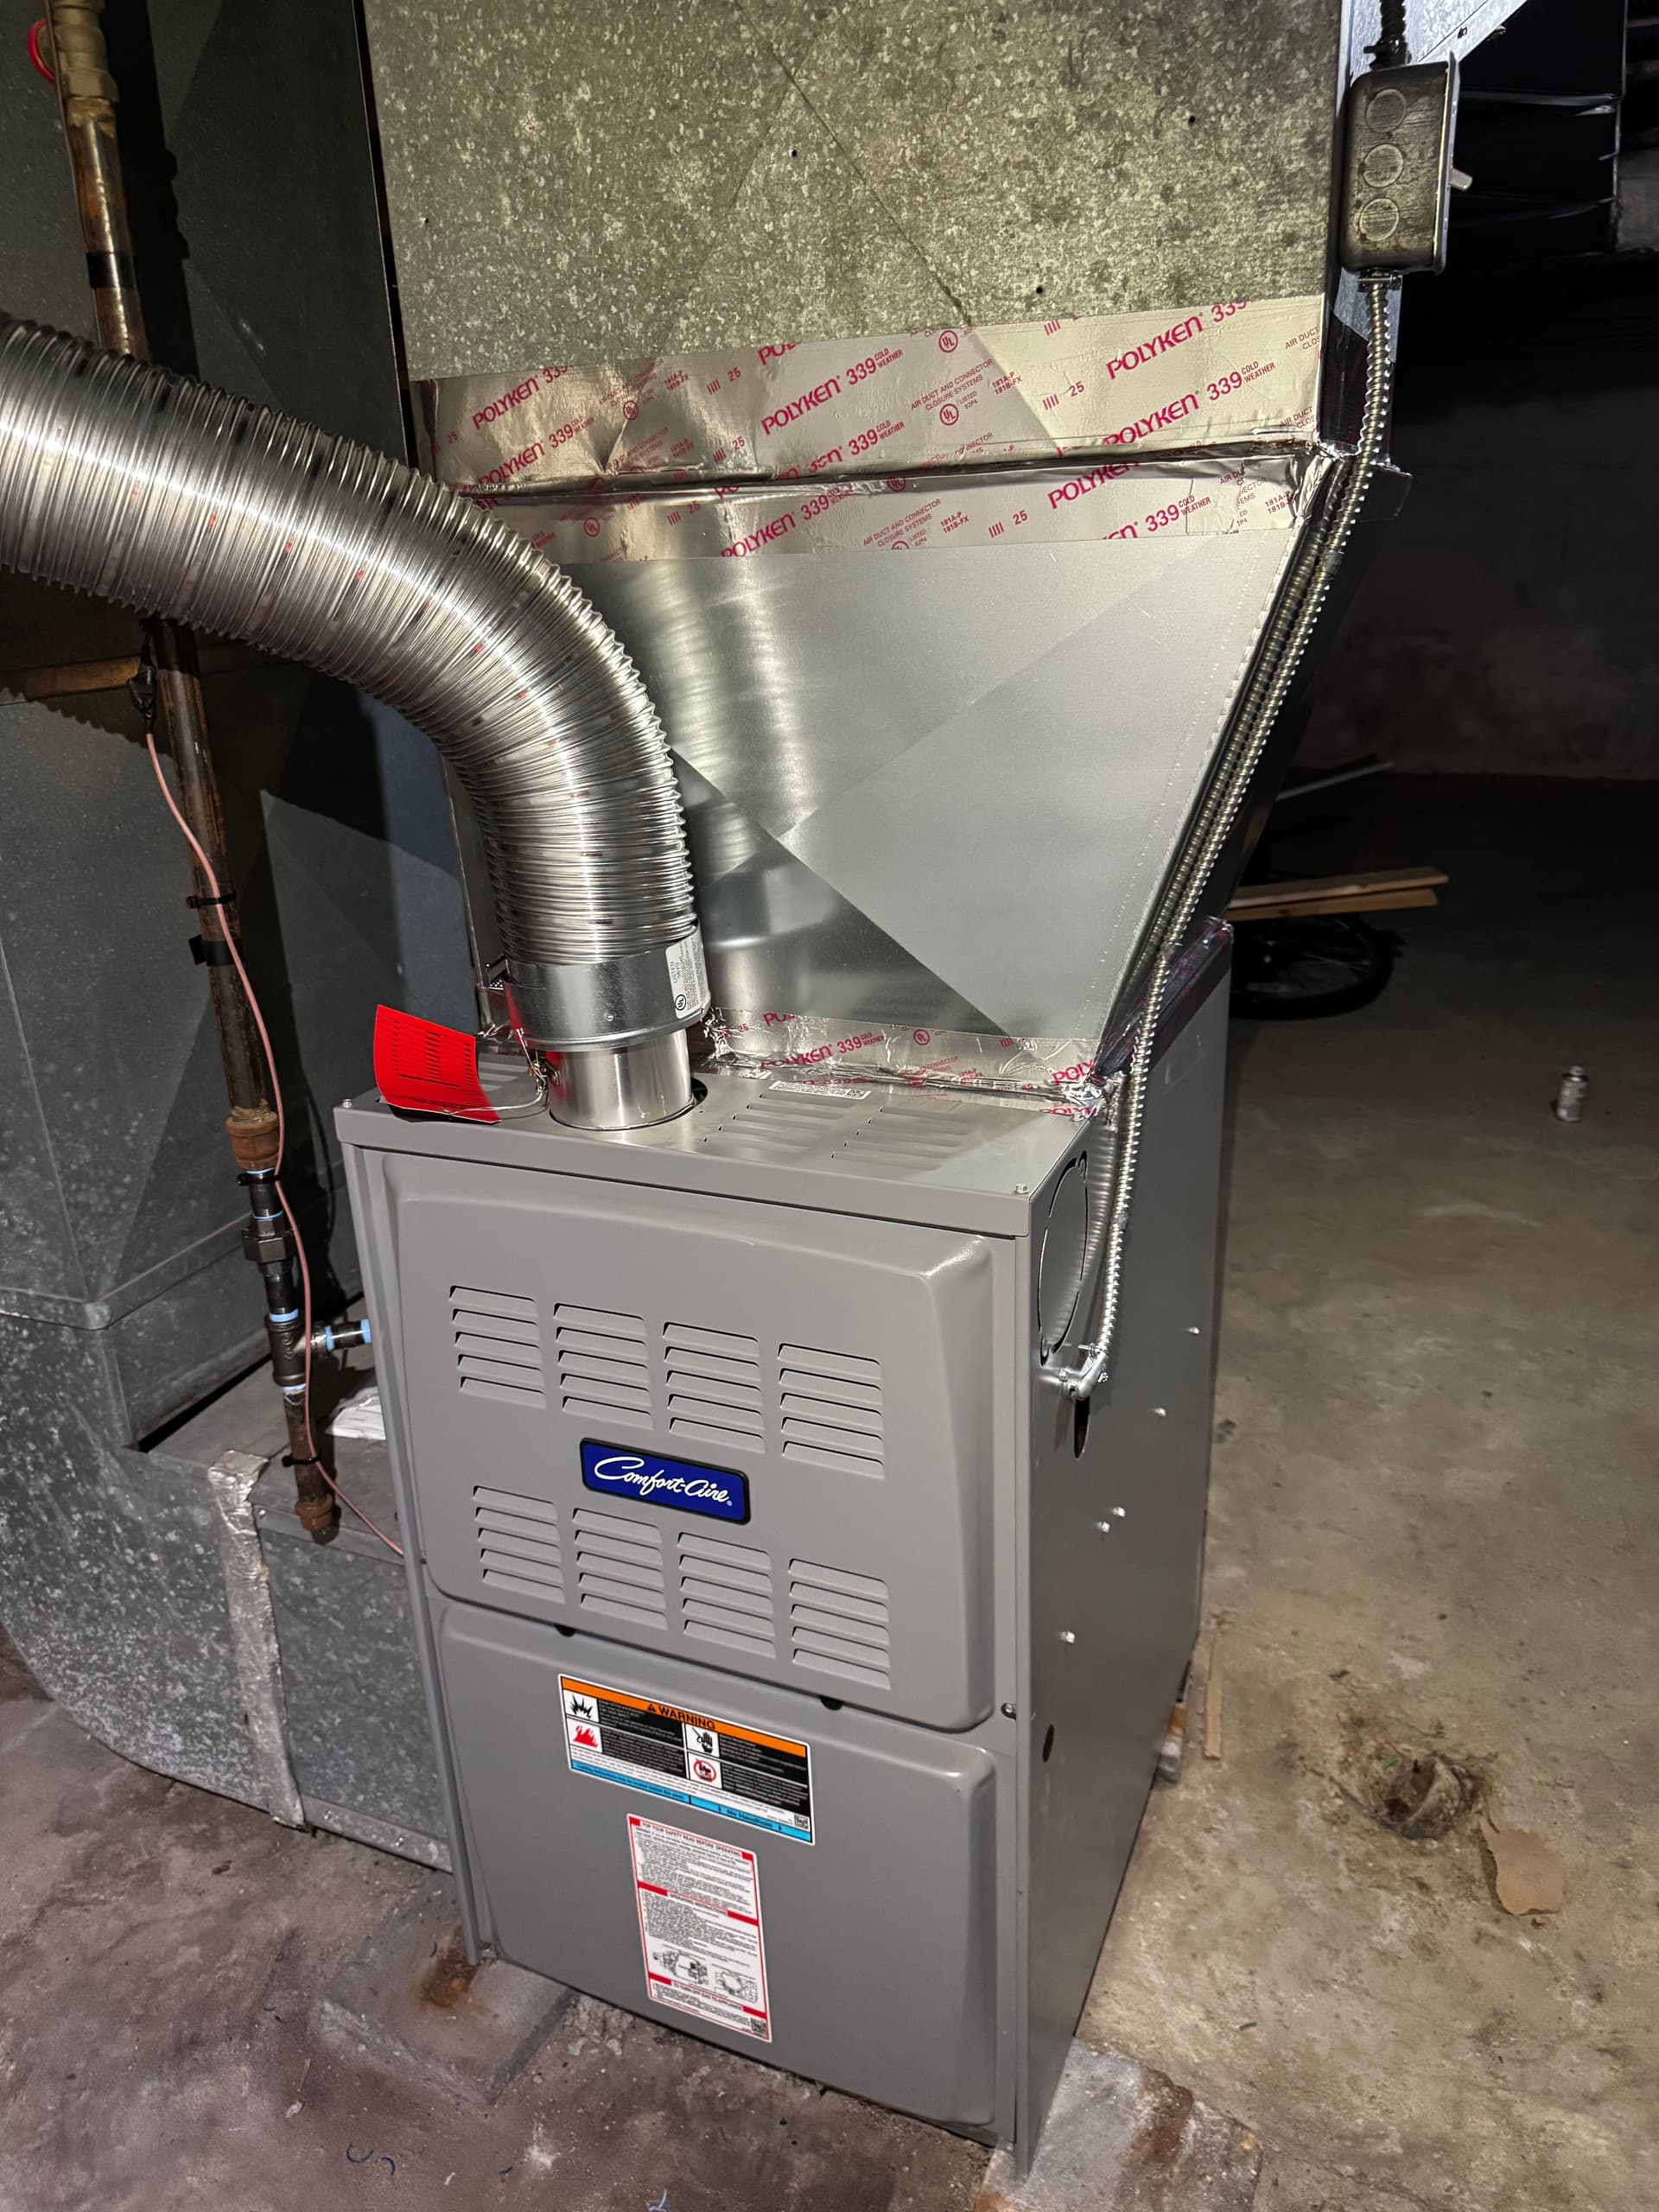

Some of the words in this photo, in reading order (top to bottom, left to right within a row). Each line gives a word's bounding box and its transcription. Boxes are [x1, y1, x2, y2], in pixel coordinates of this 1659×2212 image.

[1105, 315, 1204, 381] POLYKEN
[1284, 337, 1298, 350] AIR
[1299, 325, 1319, 341] DUCT
[877, 348, 904, 369] WEATHER
[728, 366, 741, 383] 25
[910, 399, 922, 410] AIR
[922, 391, 939, 405] DUCT
[940, 381, 954, 394] AND
[954, 358, 994, 385] CONNECTOR
[1243, 361, 1276, 384] WEATHER
[760, 377, 842, 435] POLYKEN
[846, 357, 876, 385] 339
[873, 347, 889, 361] COLD
[925, 390, 954, 411] CLOSURE
[954, 373, 984, 395] SYSTEMS
[958, 390, 978, 405] LISTED
[1068, 381, 1085, 397] 25
[472, 377, 540, 430] POLYKEN
[1103, 391, 1200, 446] POLYKEN
[1206, 371, 1243, 402] 339
[1240, 360, 1259, 376] COLD
[1294, 405, 1313, 423] DUCT
[549, 423, 575, 448] 339
[732, 435, 746, 451] 25
[848, 429, 879, 456] 339
[875, 419, 892, 432] COLD
[878, 421, 906, 440] WEATHER
[1046, 462, 1141, 510] POLYKE
[1219, 474, 1231, 485] AIR
[800, 494, 830, 521] 339
[940, 511, 963, 528] 181A-P
[1013, 510, 1028, 526] 25
[1145, 504, 1179, 533] 339
[1177, 494, 1196, 509] COLD
[1180, 496, 1211, 518] WEATHER
[863, 536, 874, 547] AIR
[874, 528, 891, 541] DUCT
[891, 519, 905, 531] AND
[905, 498, 942, 524] CONNECTOR
[877, 528, 905, 548] CLOSURE
[904, 512, 933, 533] SYSTEMS
[836, 1037, 861, 1054] 339
[594, 1456, 729, 1503] Comfort-Aire
[658, 1706, 715, 1730] WARNING
